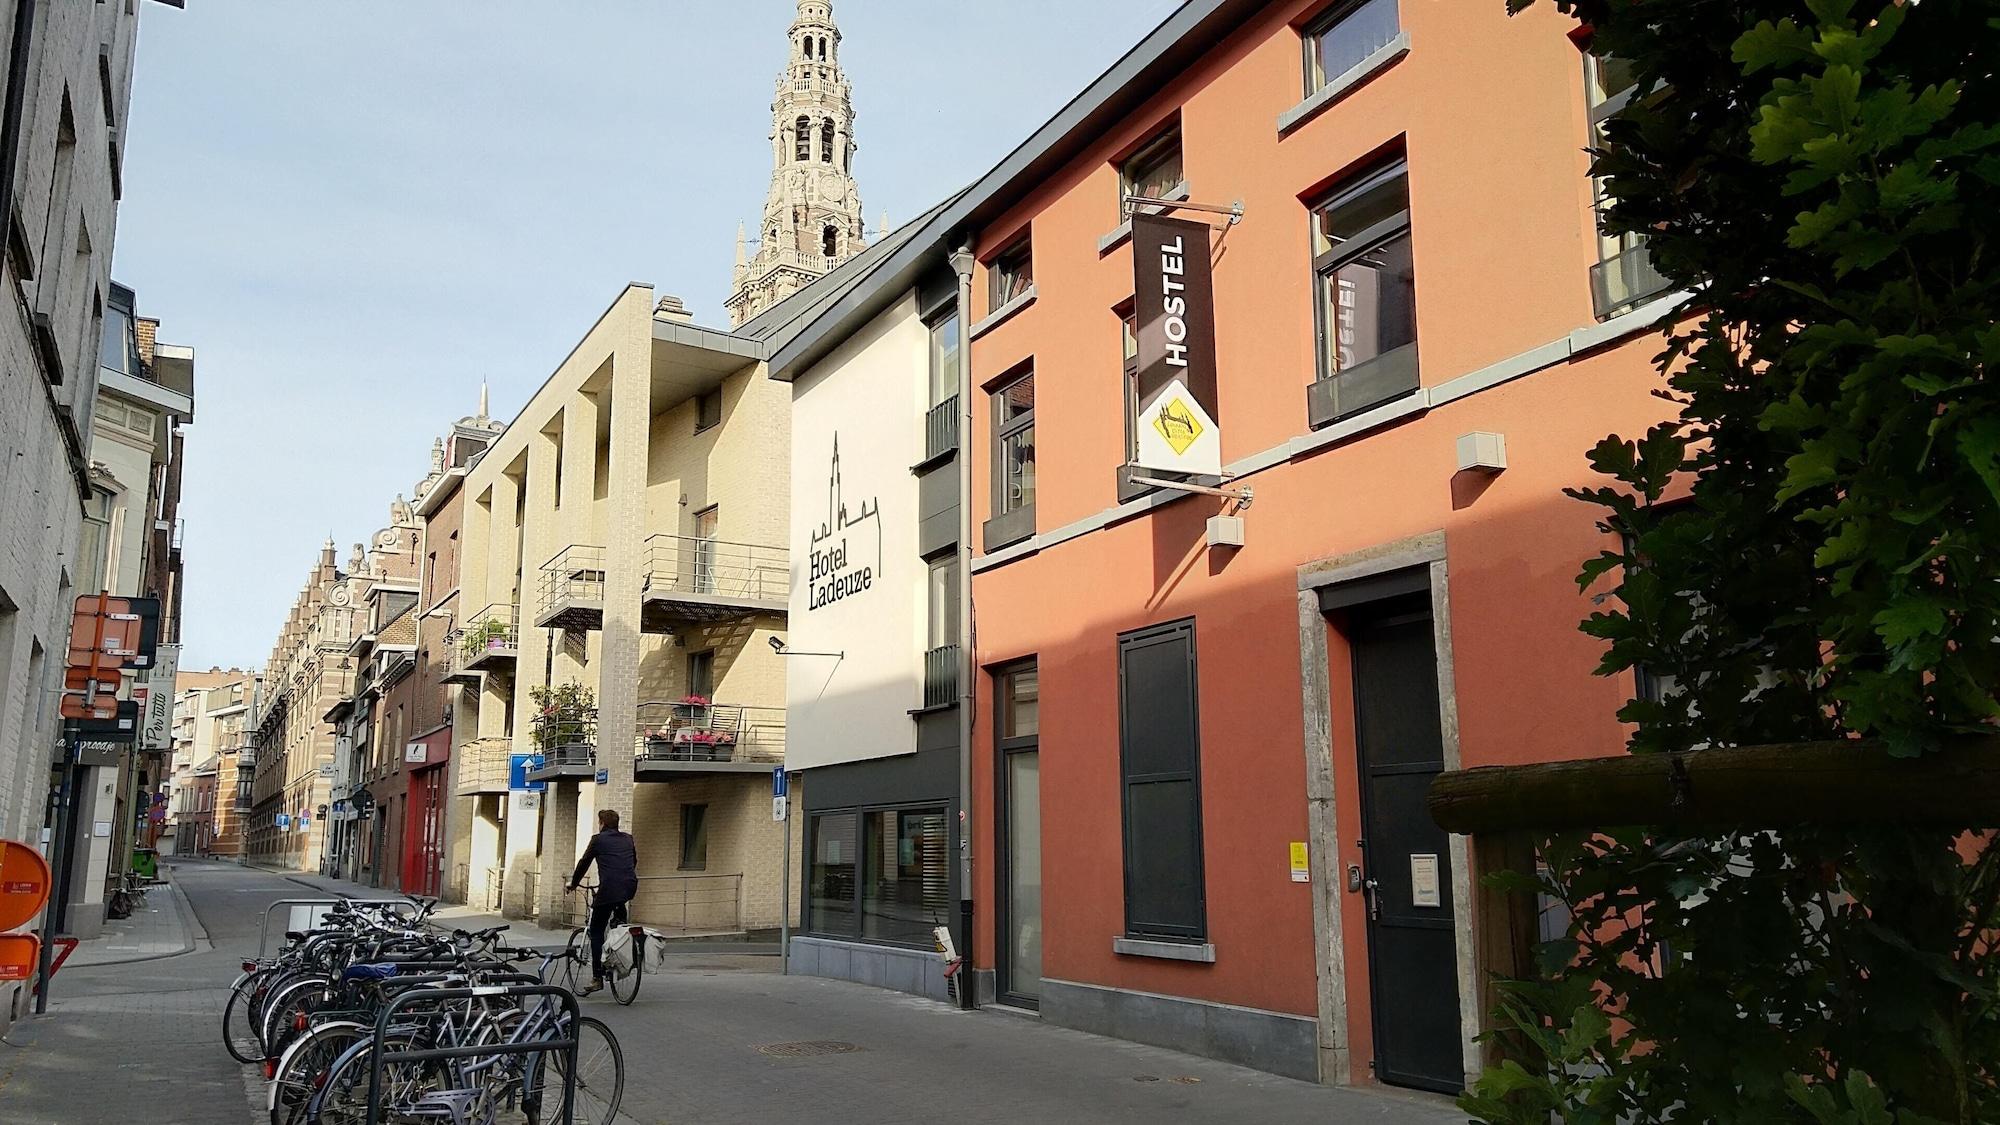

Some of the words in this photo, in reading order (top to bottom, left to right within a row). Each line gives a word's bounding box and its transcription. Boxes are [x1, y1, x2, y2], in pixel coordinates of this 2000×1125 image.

[1161, 235, 1188, 367] HOSTEL
[809, 538, 848, 582] Hotel
[809, 566, 872, 611] Ladeuze
